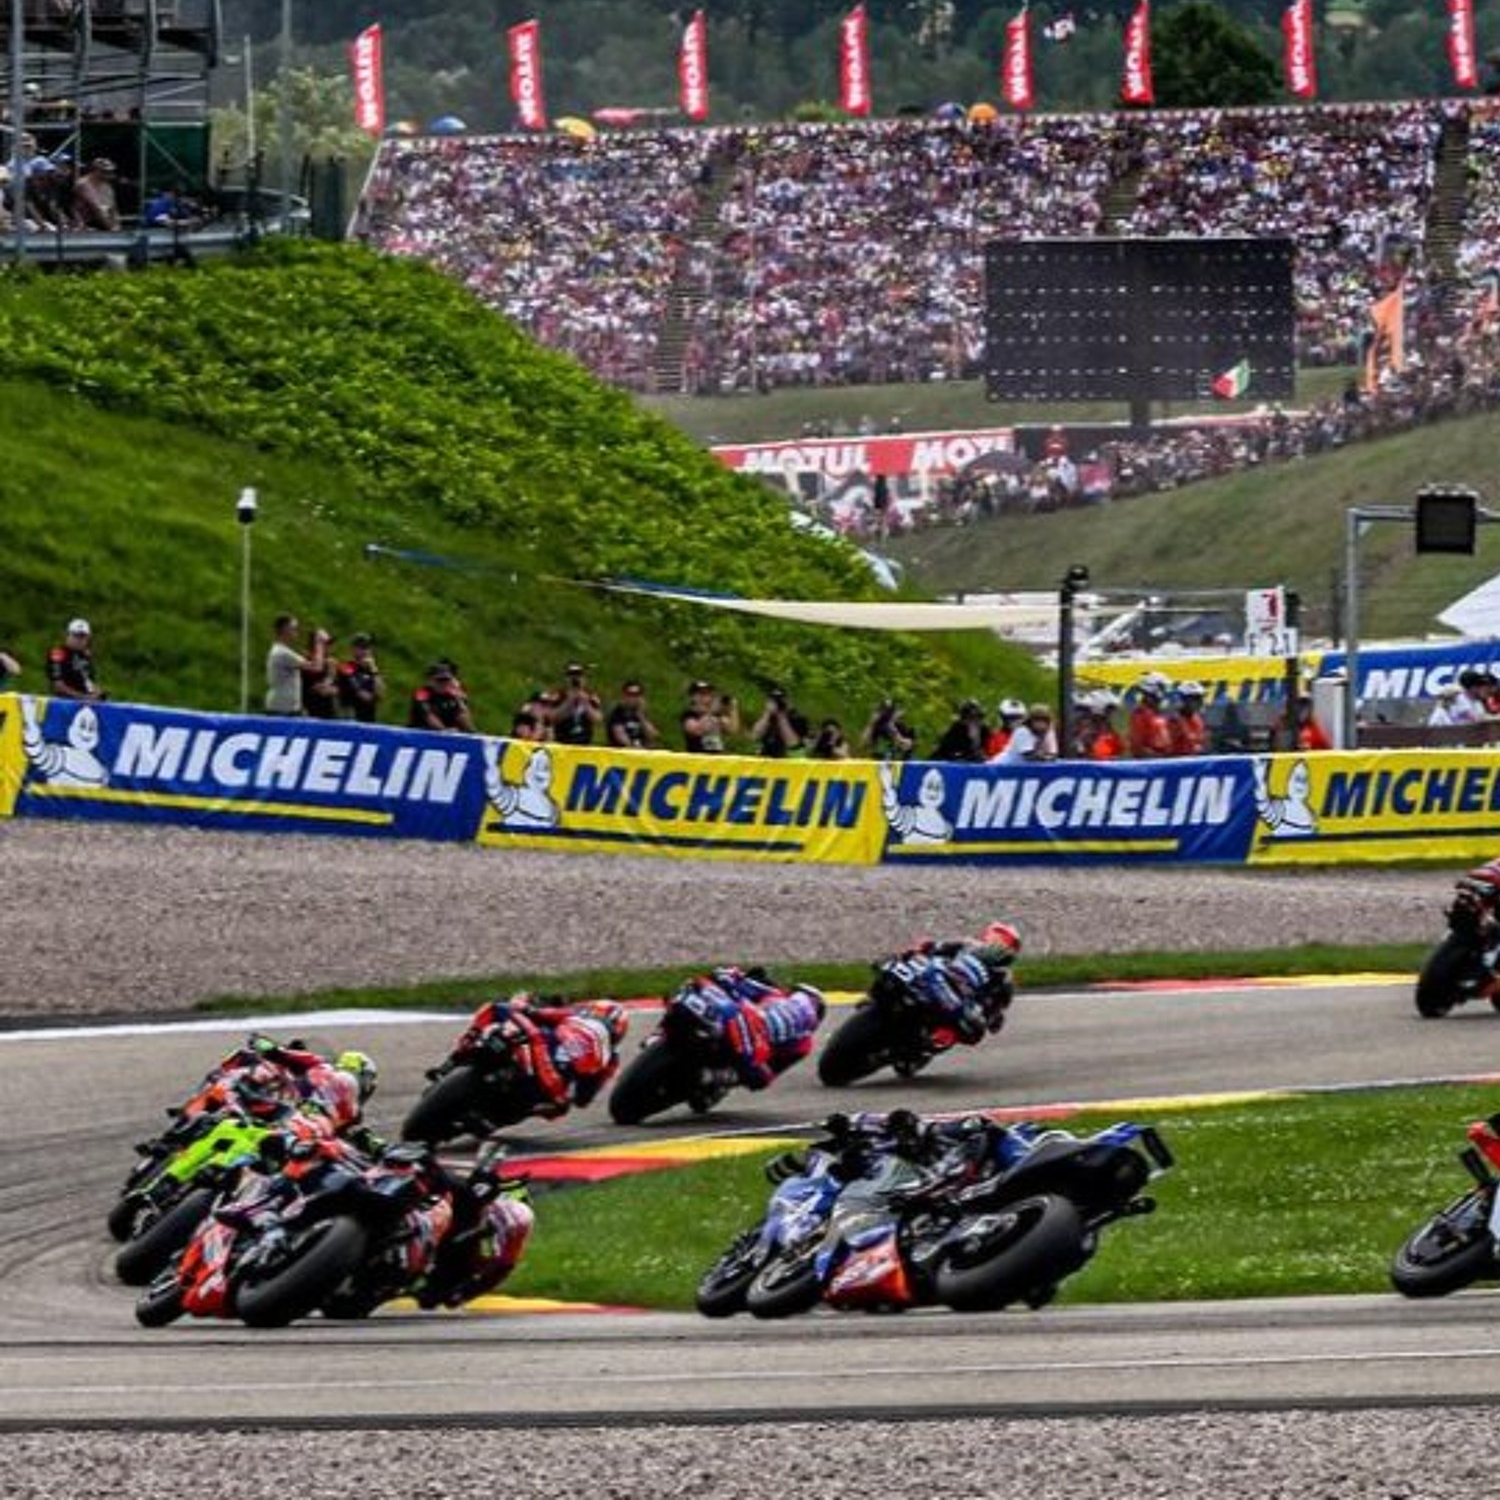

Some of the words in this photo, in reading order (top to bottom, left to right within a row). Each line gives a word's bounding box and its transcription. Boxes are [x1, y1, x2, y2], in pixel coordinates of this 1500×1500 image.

[742, 444, 872, 473] MOTUL
[113, 722, 469, 804] MICHELIN
[565, 763, 868, 829] MICHELIN
[956, 775, 1237, 830] MICHELIN
